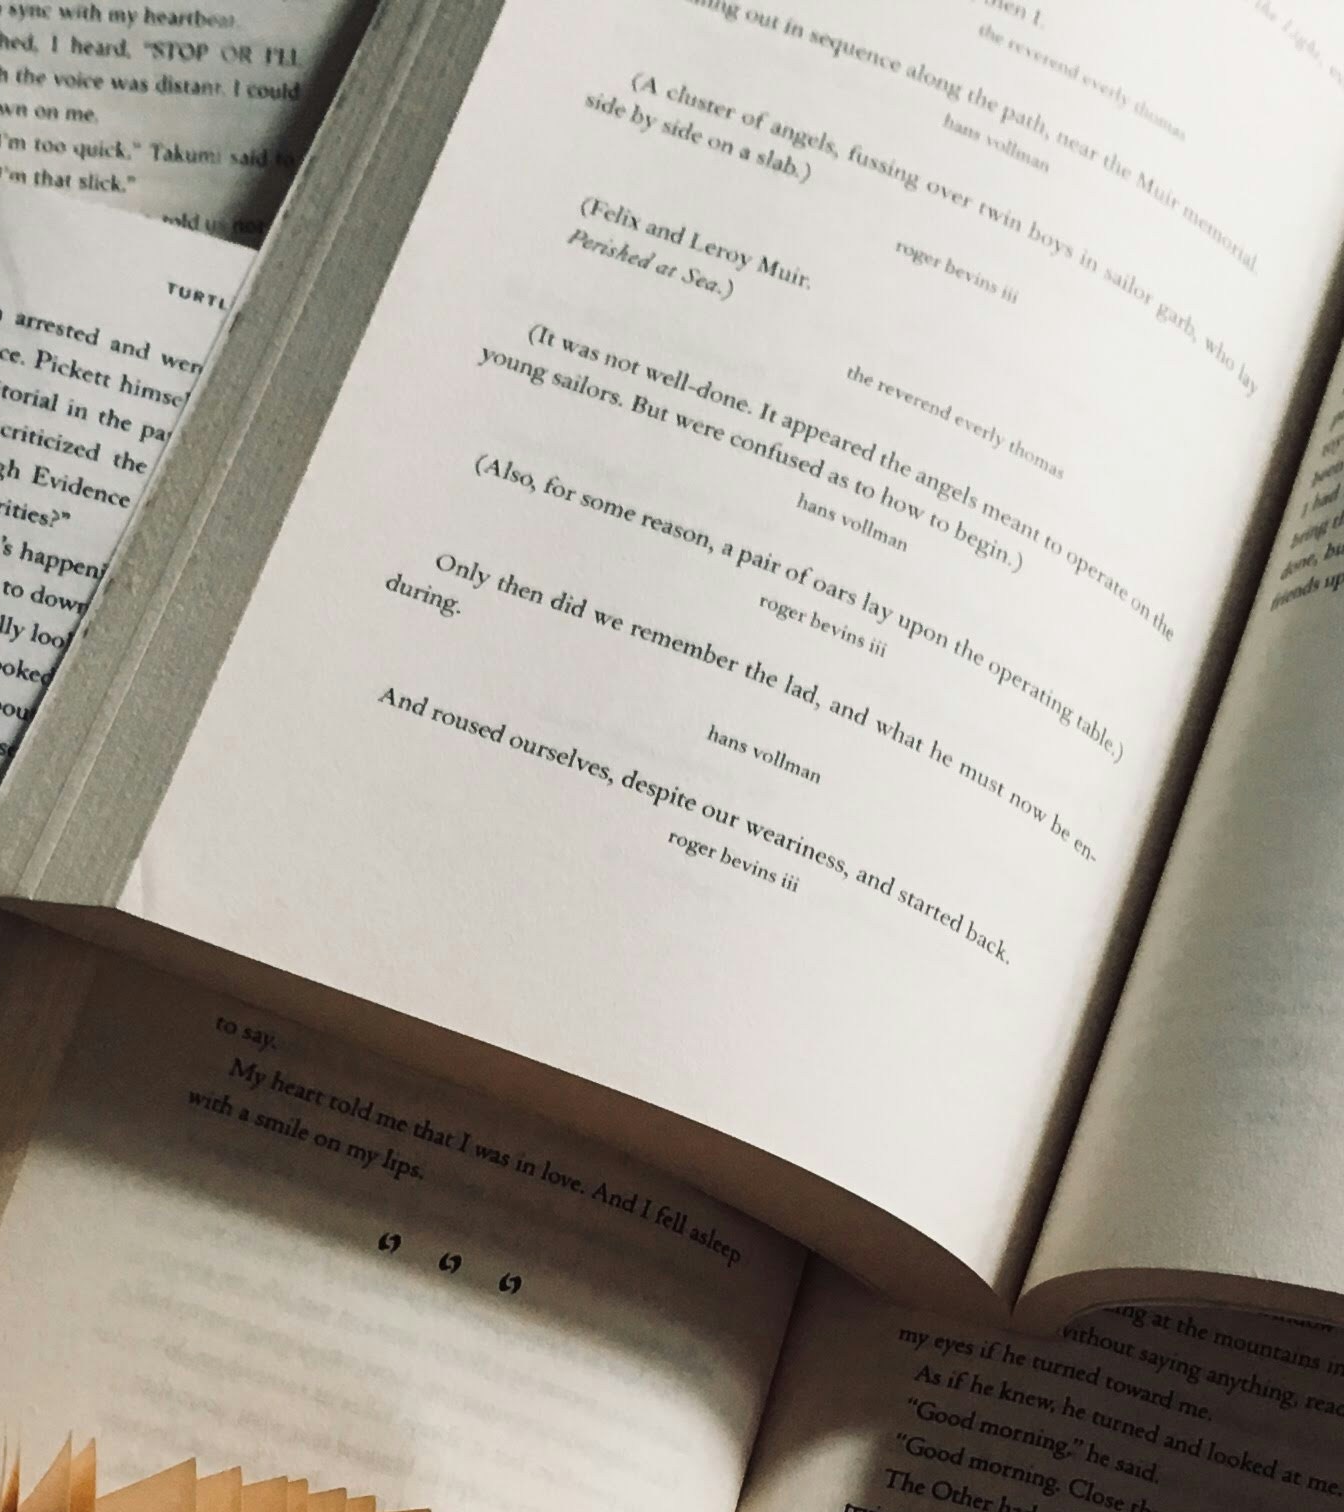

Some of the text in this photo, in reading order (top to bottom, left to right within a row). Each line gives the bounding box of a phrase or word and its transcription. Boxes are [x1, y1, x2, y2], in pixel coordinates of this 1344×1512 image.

[566, 227, 734, 301] Perished at Sea.)
[579, 197, 810, 289] (Felix and Leroy Muir.
[846, 364, 1064, 479] the reverend everly thomas
[30, 464, 130, 508] Evidence
[795, 491, 907, 552] hans vollman
[376, 686, 1009, 965] And roused ourselves, despite our weariness, and started back.
[227, 1056, 741, 1268] My heart told me that I was in love. And I fell asleep
[895, 1431, 966, 1466] “Good
[966, 1455, 1061, 1497] morning.
[1067, 1477, 1125, 1512] Close
